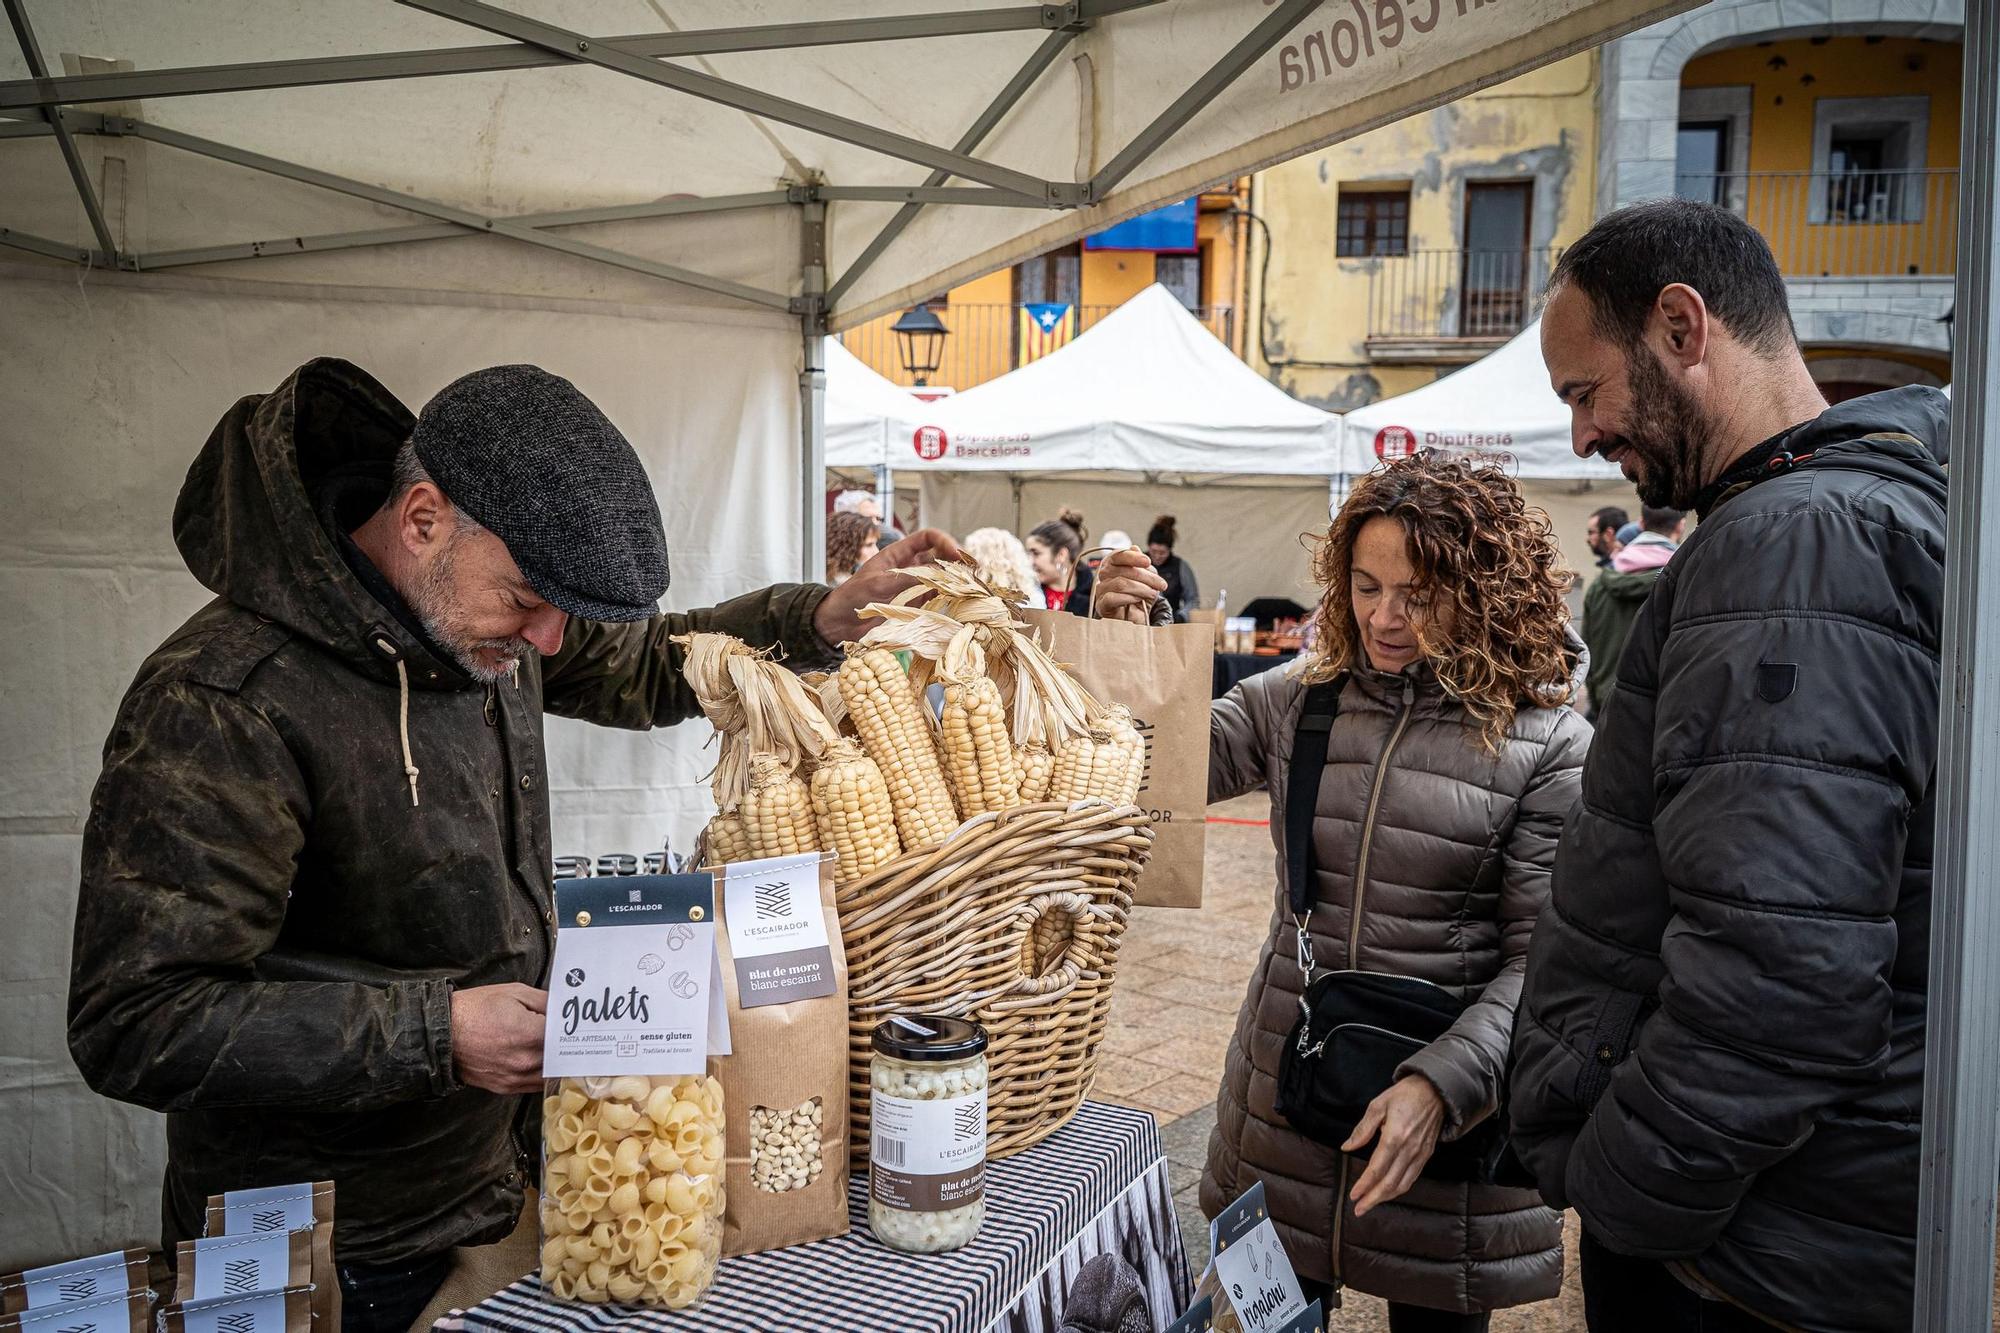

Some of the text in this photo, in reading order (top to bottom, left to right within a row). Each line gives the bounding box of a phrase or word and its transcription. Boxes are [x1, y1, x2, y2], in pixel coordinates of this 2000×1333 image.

[1425, 432, 1513, 447] Diputació
[956, 445, 1031, 457] Barcelona
[608, 903, 663, 913] L'ESCAIRADOR
[743, 921, 809, 936] L'ESCAIRADOR
[748, 963, 820, 980] Blat de moro
[750, 973, 822, 991] blanc escairat
[562, 986, 650, 1036] galets
[640, 1031, 693, 1042] sense gluten
[941, 1182, 960, 1192] Blat
[960, 1178, 970, 1188] de
[940, 1190, 964, 1201] blanc
[1243, 1277, 1287, 1330] rigatoni
